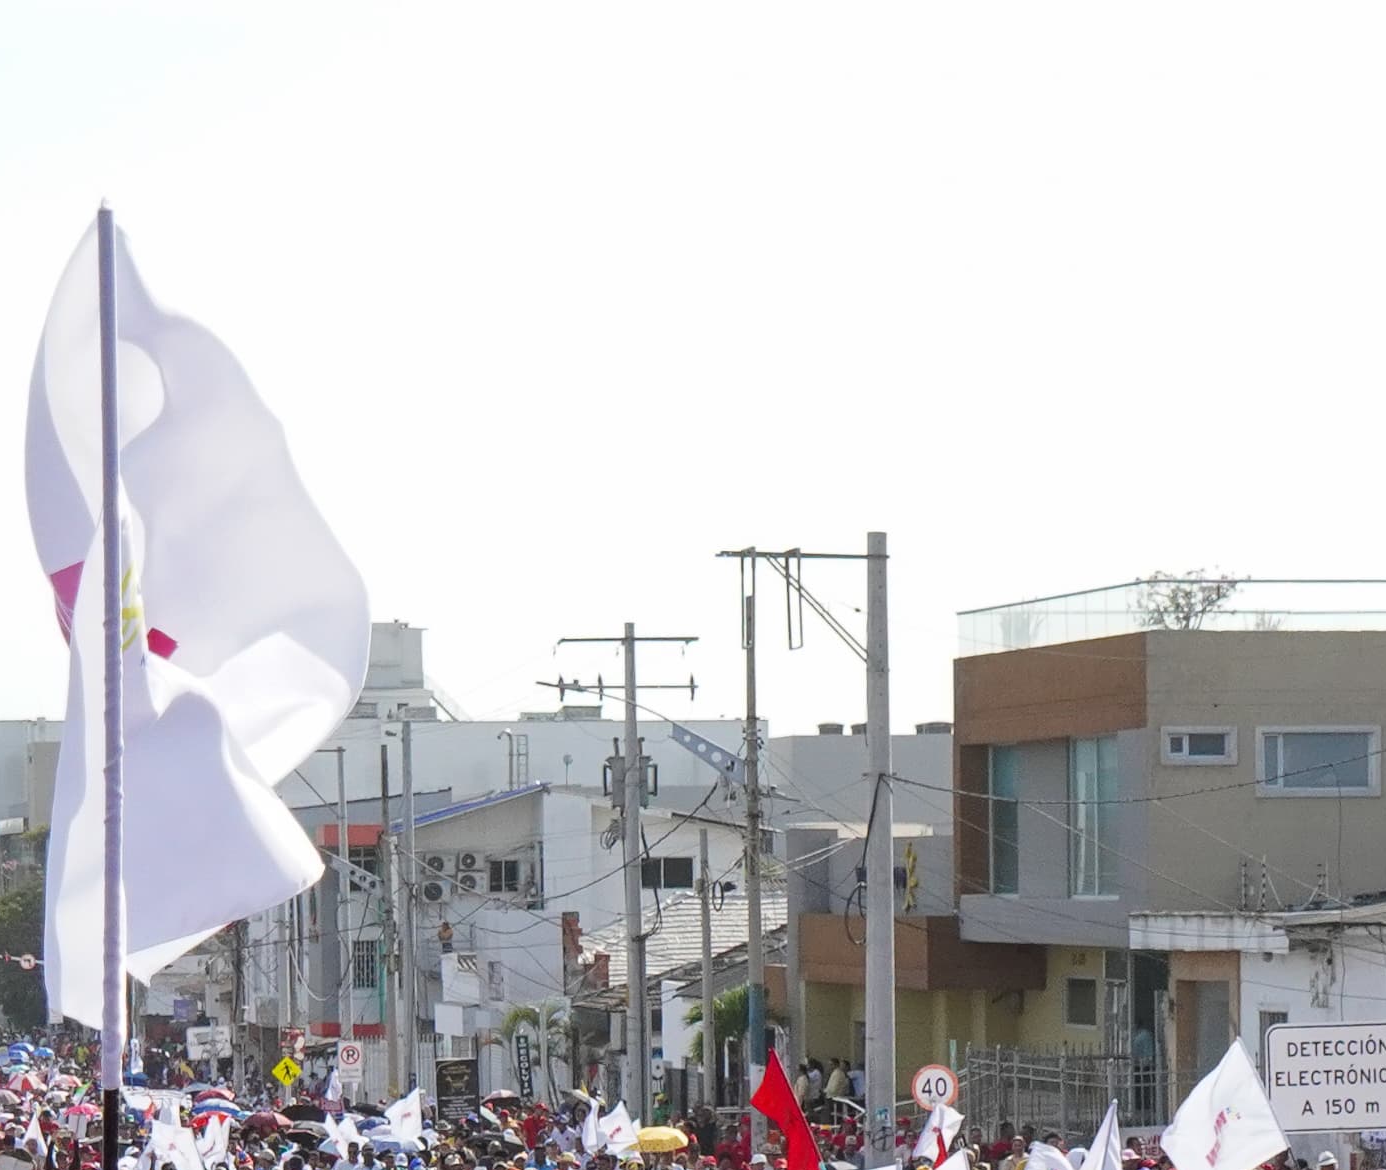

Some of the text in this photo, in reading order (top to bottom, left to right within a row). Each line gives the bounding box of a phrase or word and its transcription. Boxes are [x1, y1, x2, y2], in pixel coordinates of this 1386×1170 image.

[921, 1077, 947, 1097] 40
[1301, 1098, 1380, 1116] A 150 m
